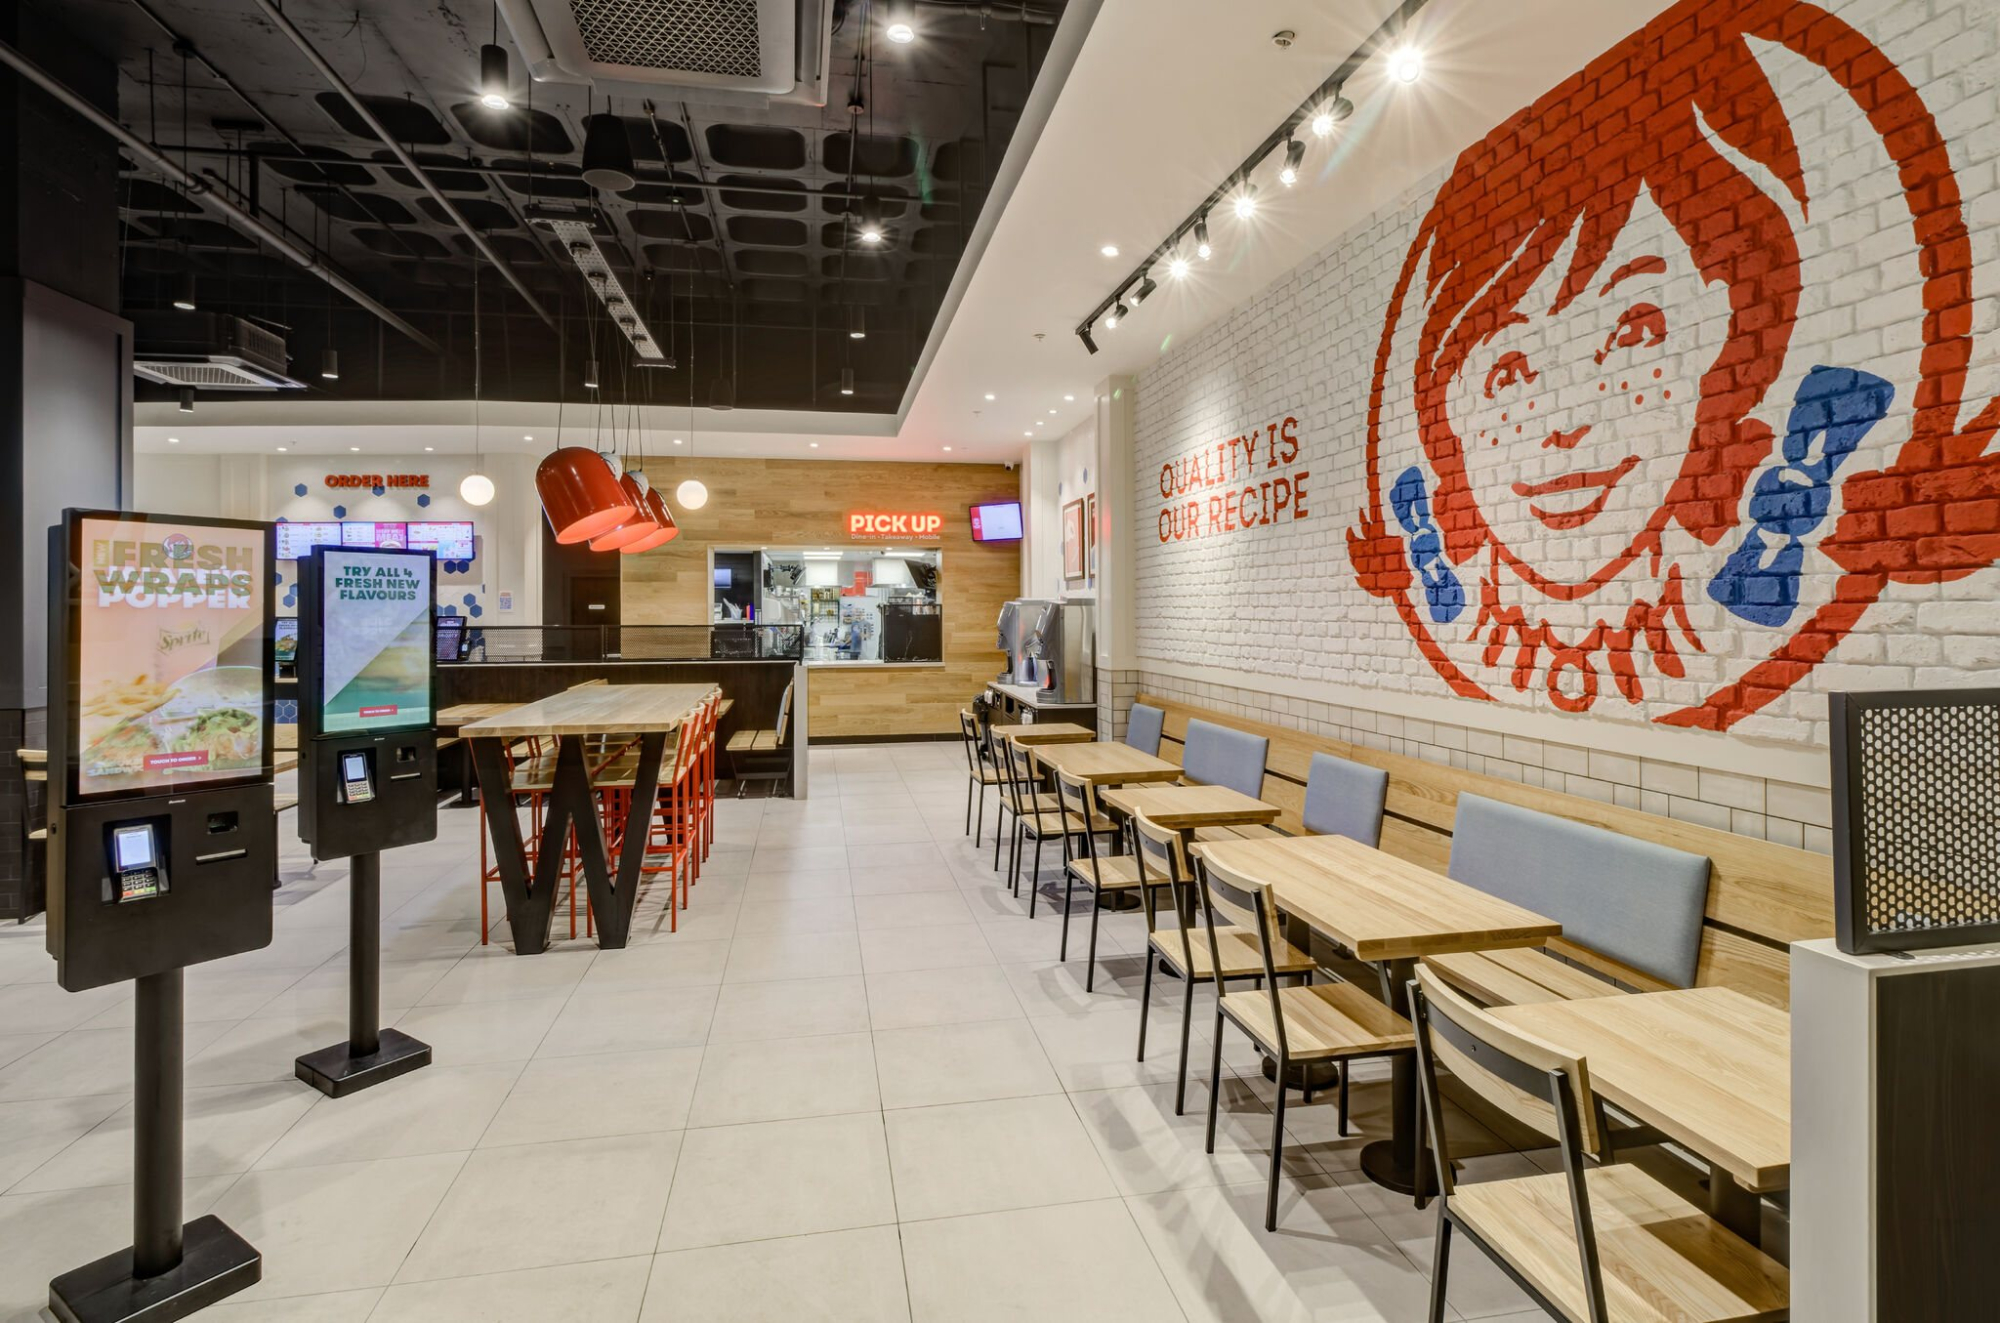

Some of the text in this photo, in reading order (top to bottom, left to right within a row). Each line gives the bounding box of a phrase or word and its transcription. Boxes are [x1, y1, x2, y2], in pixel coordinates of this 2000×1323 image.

[1159, 416, 1300, 499] QUALITY IS
[325, 474, 430, 488] ORDER HERE
[1158, 471, 1310, 543] OUR RECIPE
[851, 514, 941, 533] PICK UP
[881, 533, 914, 541] Takeaway
[113, 541, 253, 571] FRESH
[343, 565, 413, 578] TRY ALL 4
[94, 570, 253, 597] WRAPS
[335, 577, 421, 590] FRESH NEW
[98, 584, 251, 609] POPPER
[340, 589, 416, 601] FLAVOURS
[160, 627, 206, 651] Sprite
